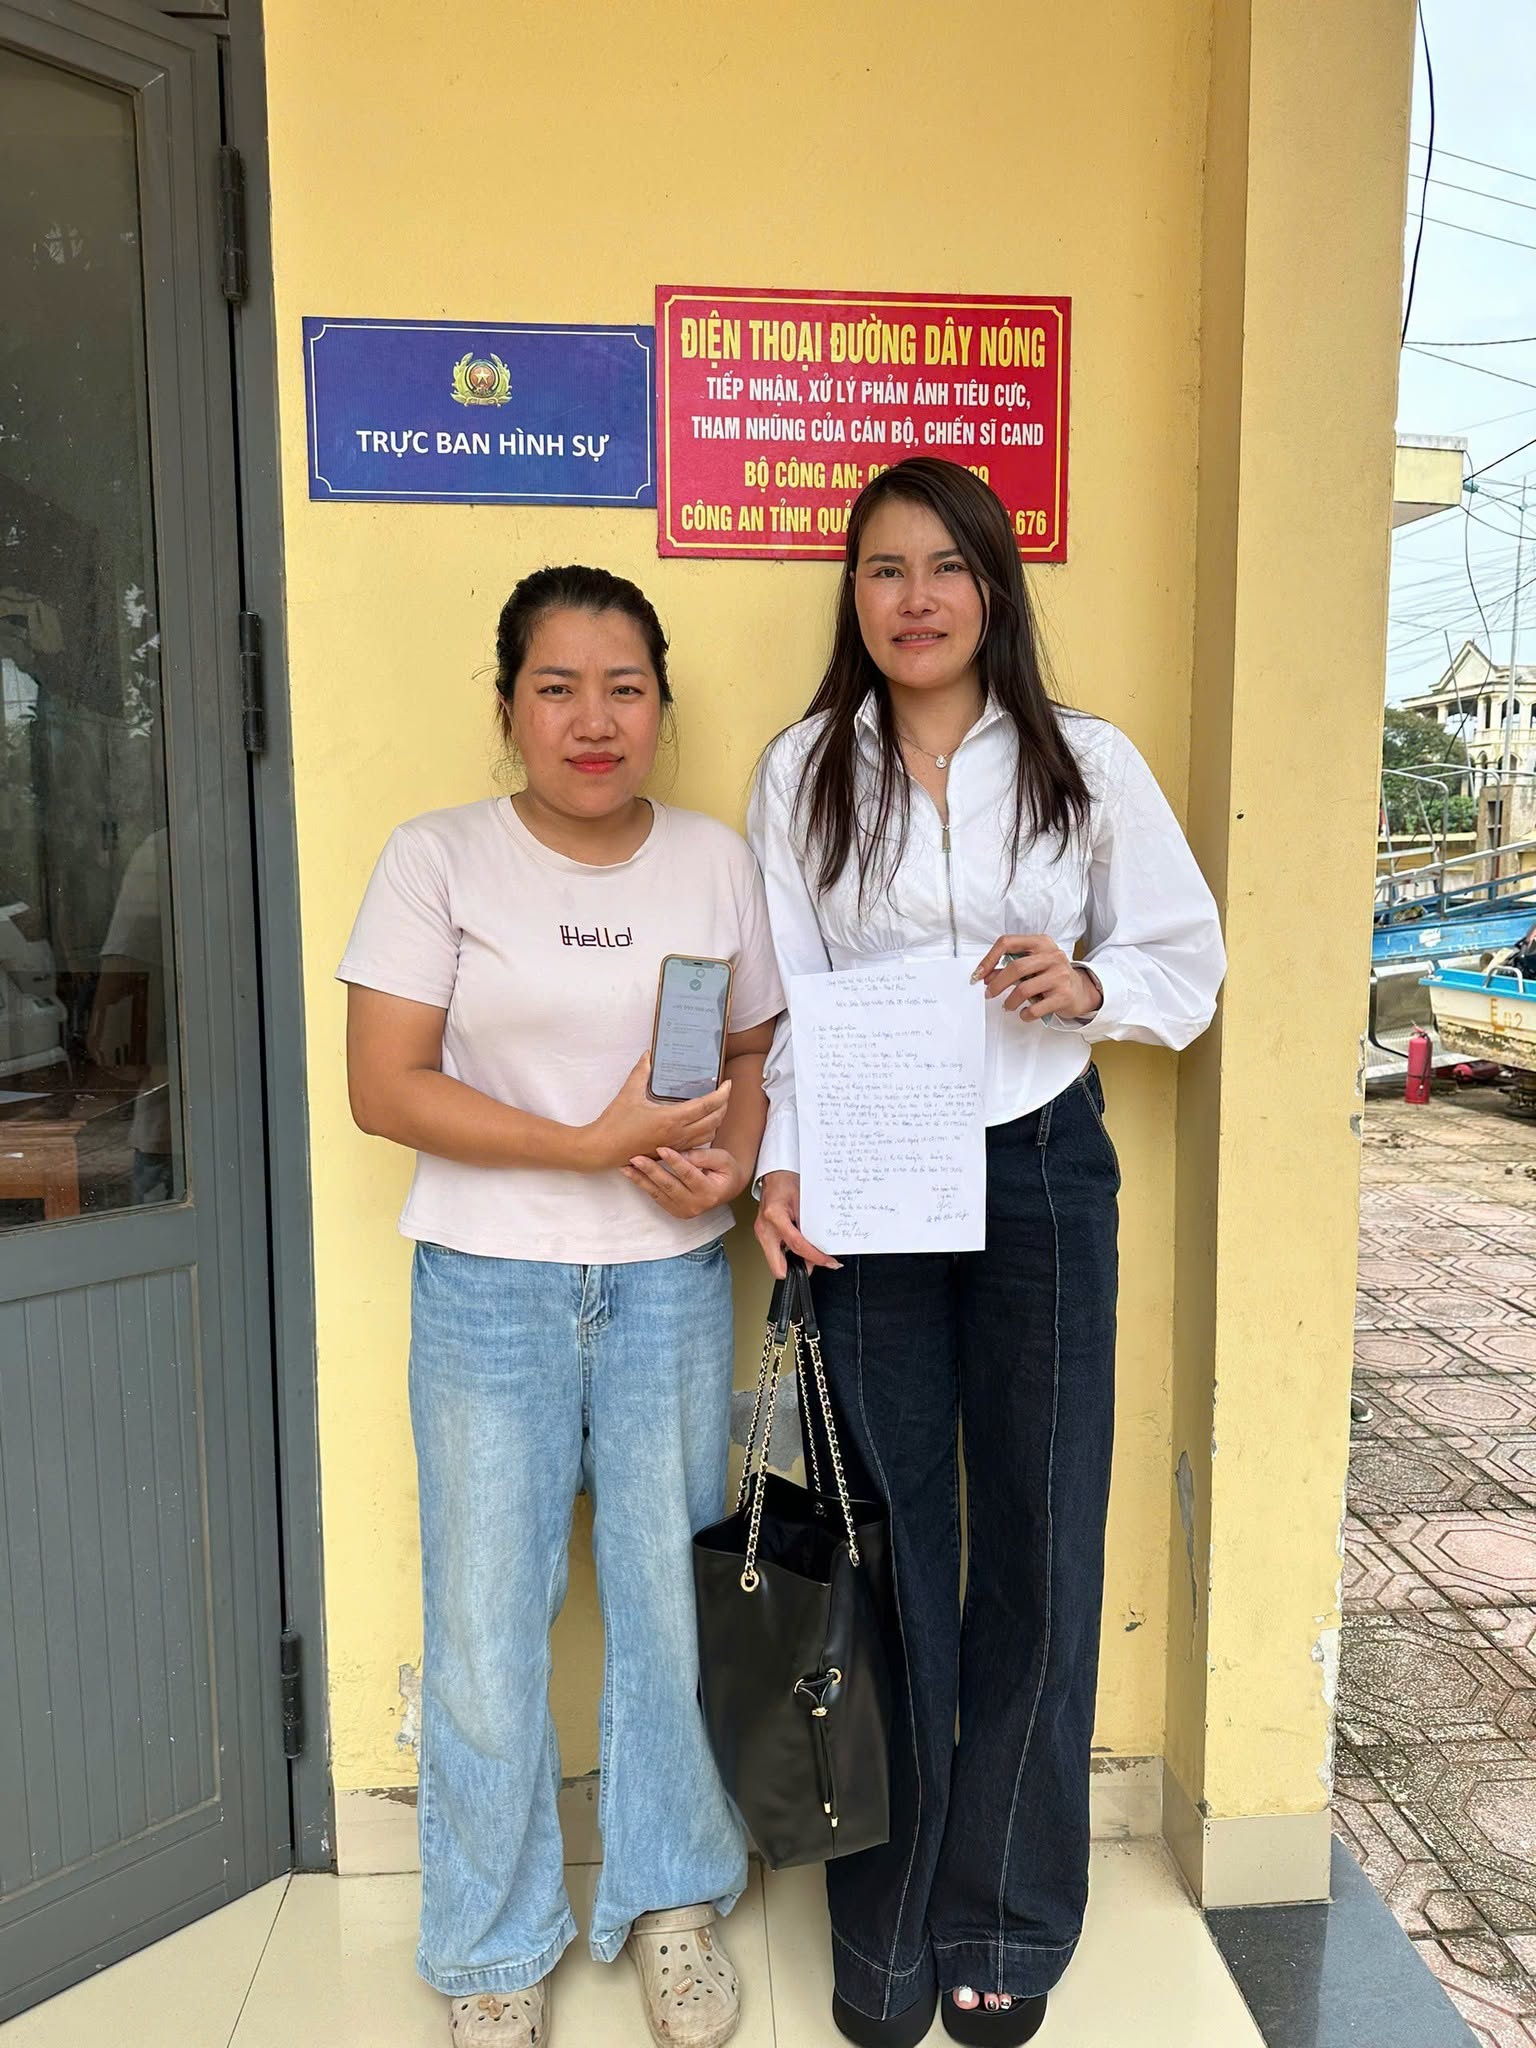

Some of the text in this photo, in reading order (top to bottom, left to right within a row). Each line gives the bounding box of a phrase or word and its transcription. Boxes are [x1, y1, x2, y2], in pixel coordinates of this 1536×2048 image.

[680, 309, 1046, 371] ĐIỆN THOẠI ĐƯỜNG DÂY NÓNG
[706, 370, 1031, 412] TIẾP NHẬN, XỬ LÝ PHẢN ÁNH TIÊU CỰC,
[356, 427, 610, 462] TRỰC BAN HÌNH SỰ
[691, 411, 1044, 449] THAM NHŨNG CỦA CÁN BỘ, CHIẾN SĨ CAND
[744, 456, 770, 493] BỘ
[775, 456, 826, 488] CÔNG
[831, 463, 863, 489] AN:
[681, 499, 733, 531] CÔNG
[737, 506, 764, 532] AN
[769, 497, 811, 533] TỈNH
[817, 499, 852, 536] QUẢ
